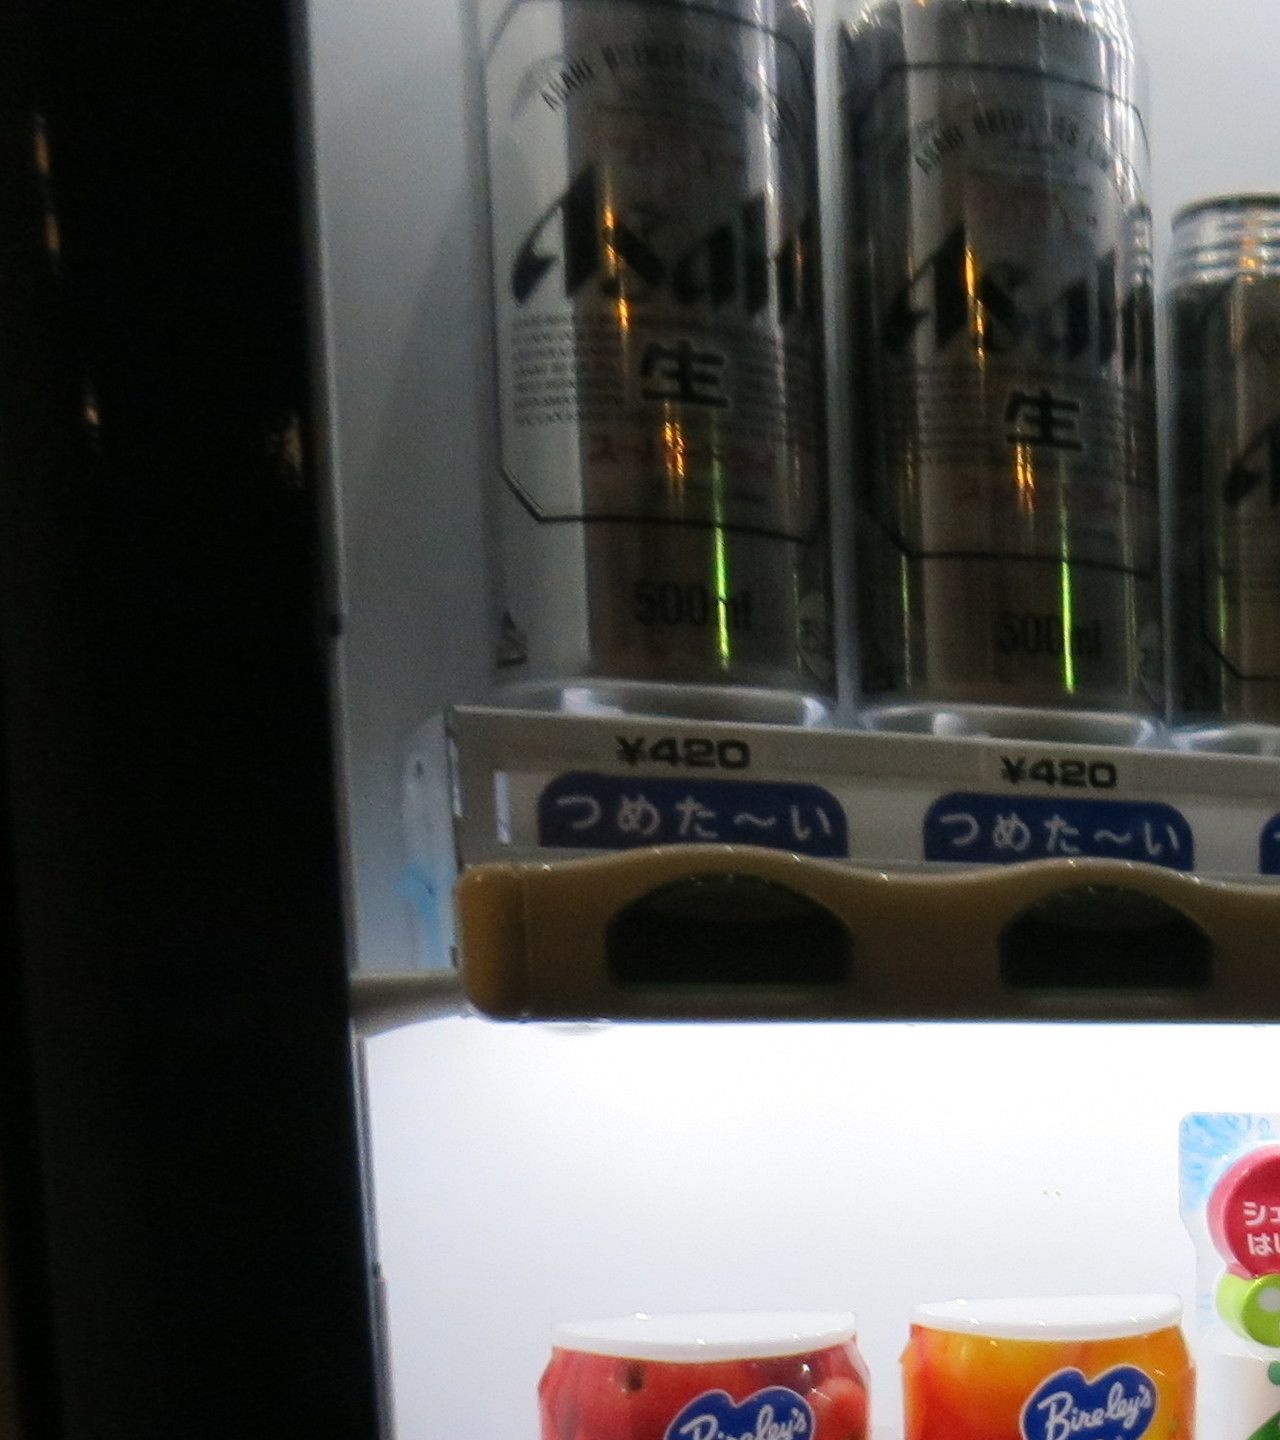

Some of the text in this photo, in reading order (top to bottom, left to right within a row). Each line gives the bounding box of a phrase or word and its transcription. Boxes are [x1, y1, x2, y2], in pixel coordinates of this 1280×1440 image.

[641, 340, 728, 408] 生
[1004, 390, 1082, 452] 生
[616, 737, 750, 769] ¥420
[1001, 756, 1116, 788] ¥420
